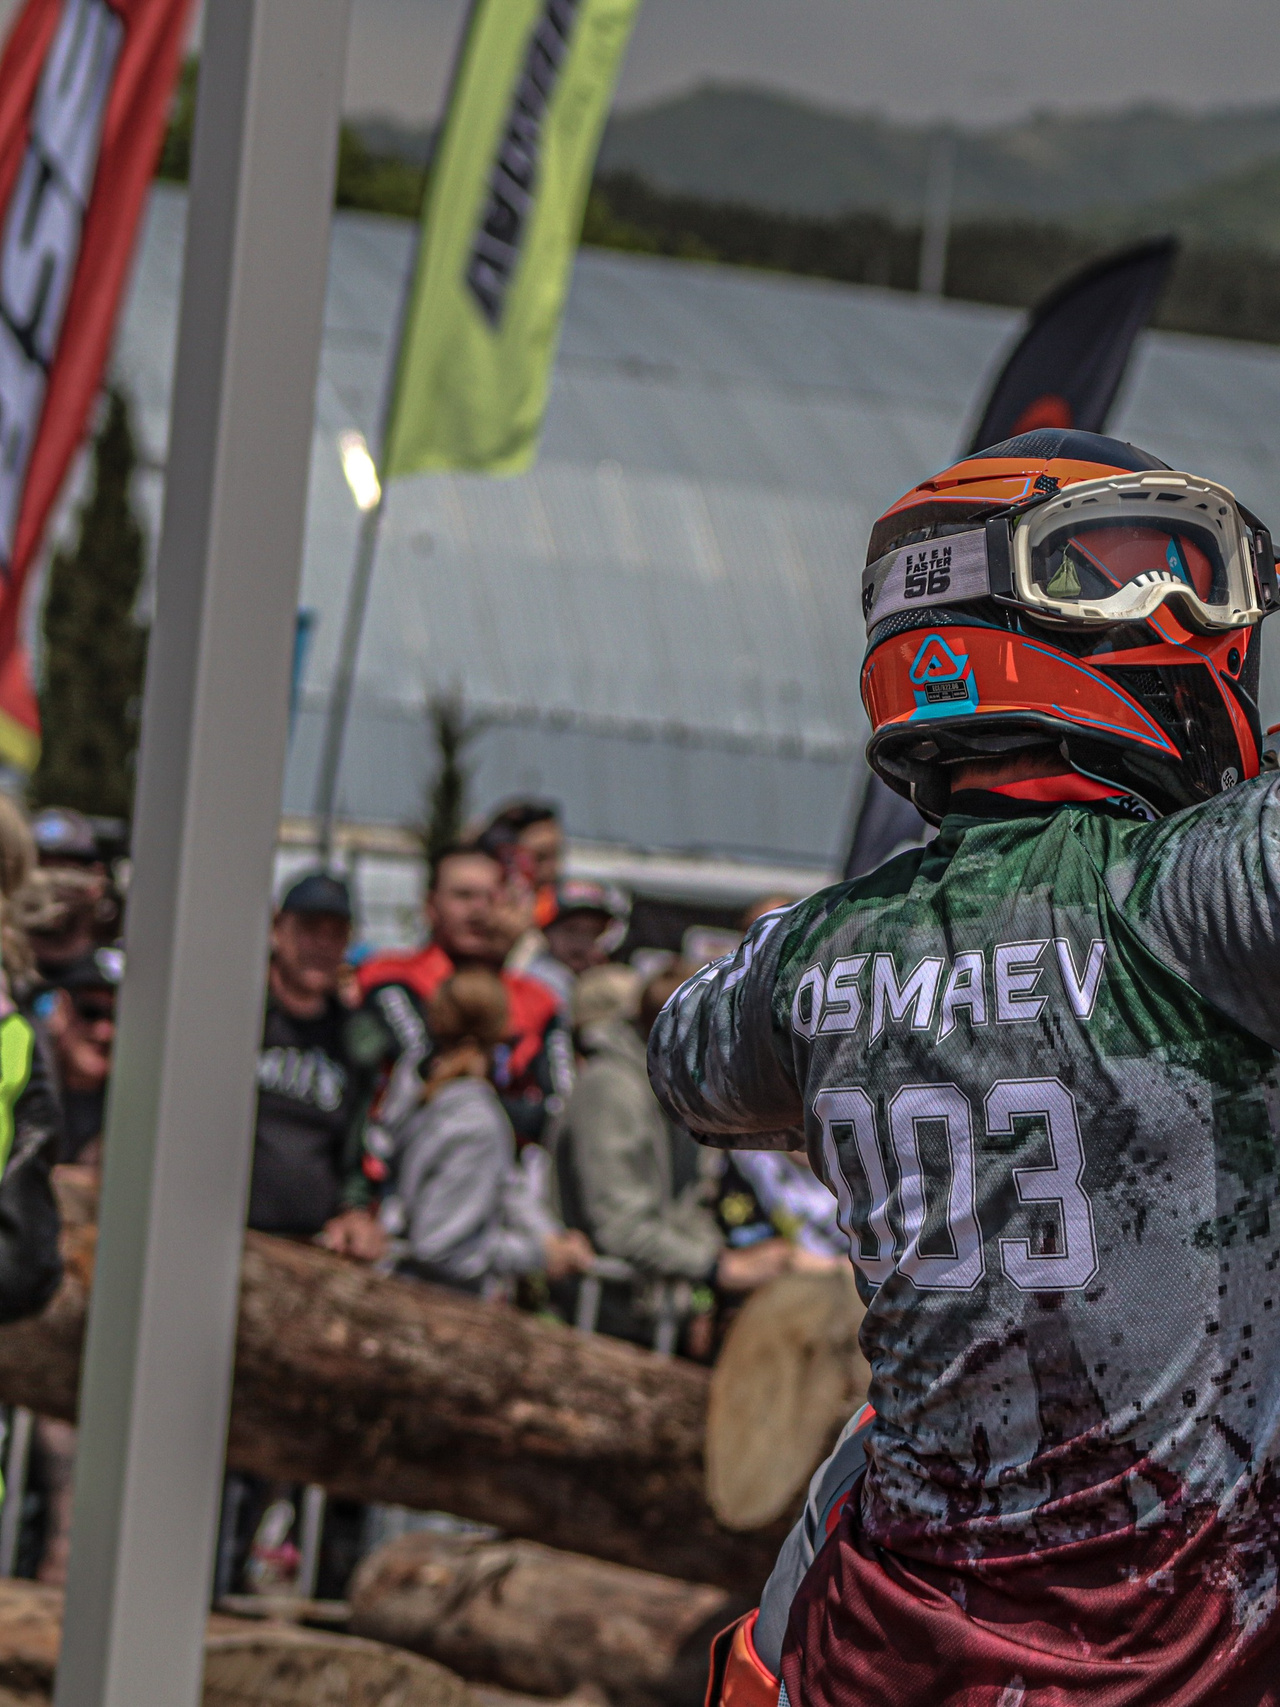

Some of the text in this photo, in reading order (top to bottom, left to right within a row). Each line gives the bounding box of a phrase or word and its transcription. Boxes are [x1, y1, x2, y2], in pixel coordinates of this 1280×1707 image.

[906, 546, 952, 566] EVEN
[906, 556, 952, 575] FASTER
[903, 567, 951, 599] 56
[791, 937, 1107, 1046] OSMAEV
[812, 1076, 1100, 1292] 003
